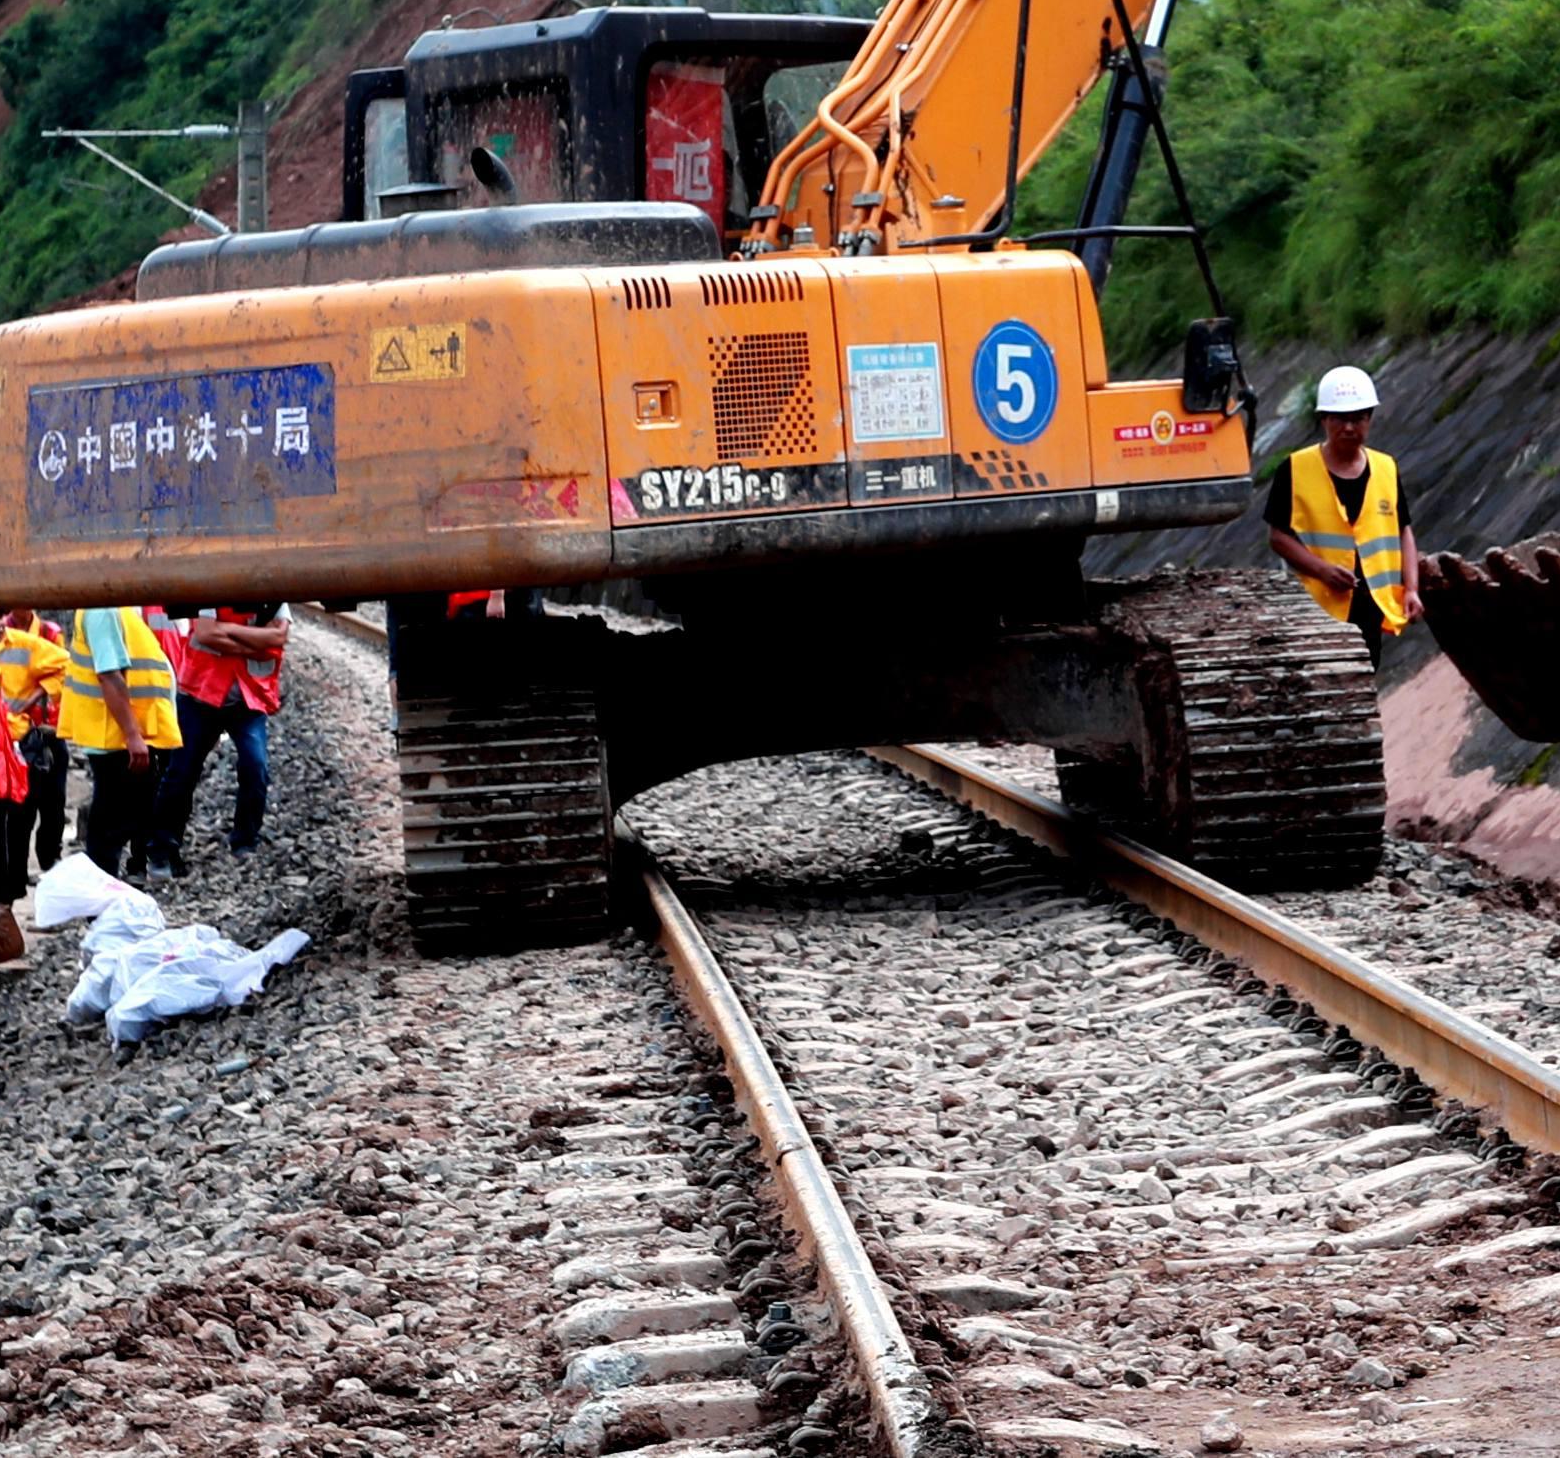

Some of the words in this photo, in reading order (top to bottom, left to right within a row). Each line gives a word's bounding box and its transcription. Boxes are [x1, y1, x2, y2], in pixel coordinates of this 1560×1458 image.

[996, 343, 1036, 423] 5
[77, 406, 310, 475] 中国中铁十局
[865, 464, 937, 491] 三一重机
